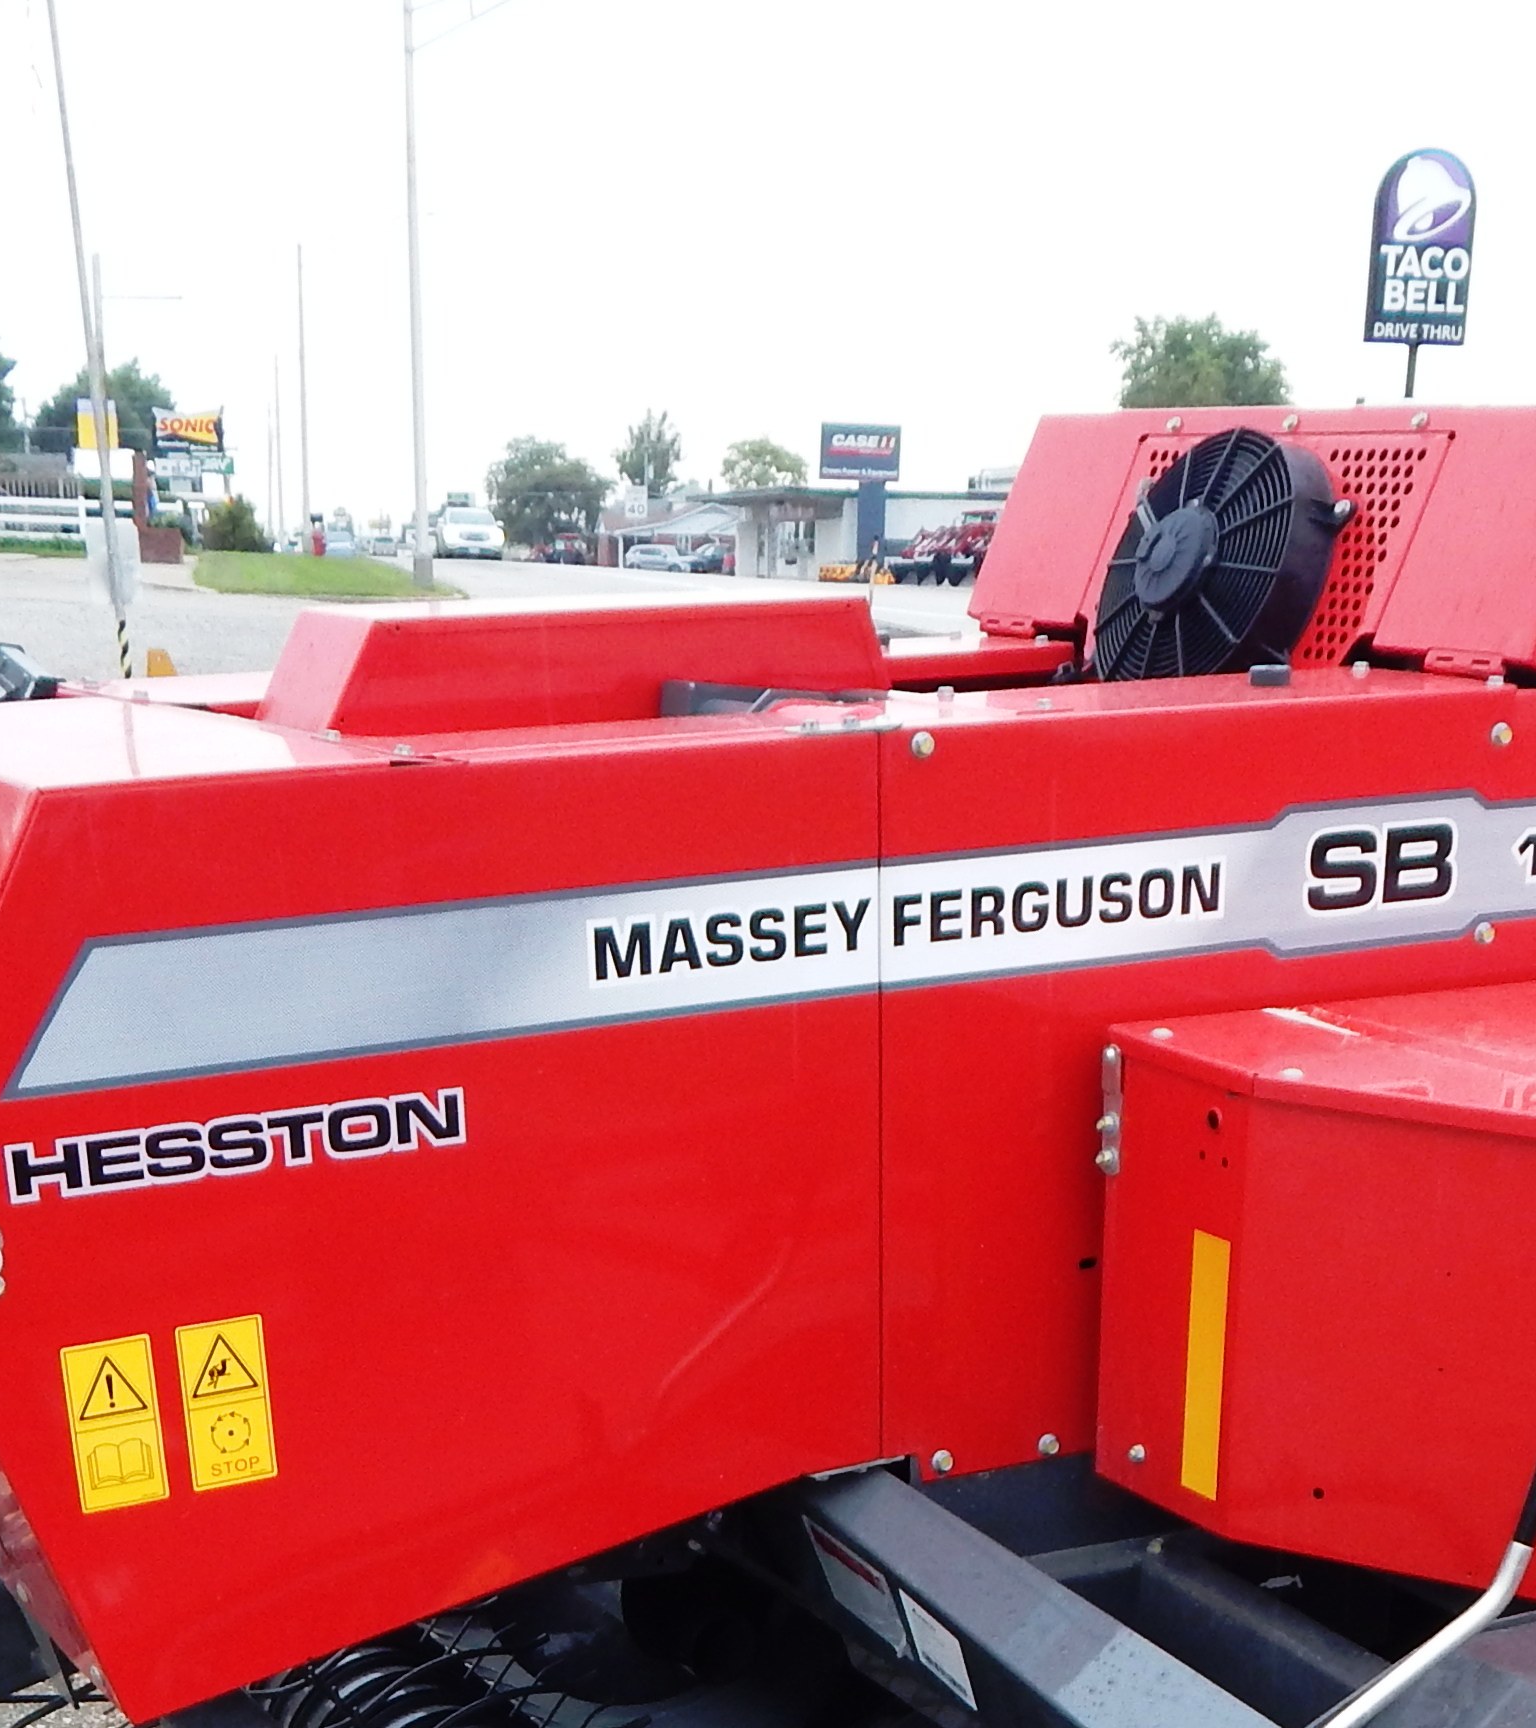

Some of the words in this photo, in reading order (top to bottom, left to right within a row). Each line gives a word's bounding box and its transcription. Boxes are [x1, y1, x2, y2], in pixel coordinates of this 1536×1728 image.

[1380, 244, 1470, 280] TACO
[1382, 278, 1465, 314] BELL
[1373, 321, 1419, 339] DRIVE
[1422, 323, 1463, 341] THRU
[159, 416, 216, 434] SONIC
[831, 433, 880, 448] CASE
[627, 503, 645, 515] 40
[593, 896, 872, 981] MASSEY
[892, 862, 1222, 947] FERGUSON
[1306, 821, 1455, 912] SB
[8, 1090, 463, 1200] HESSTON
[210, 1455, 261, 1478] STOP
